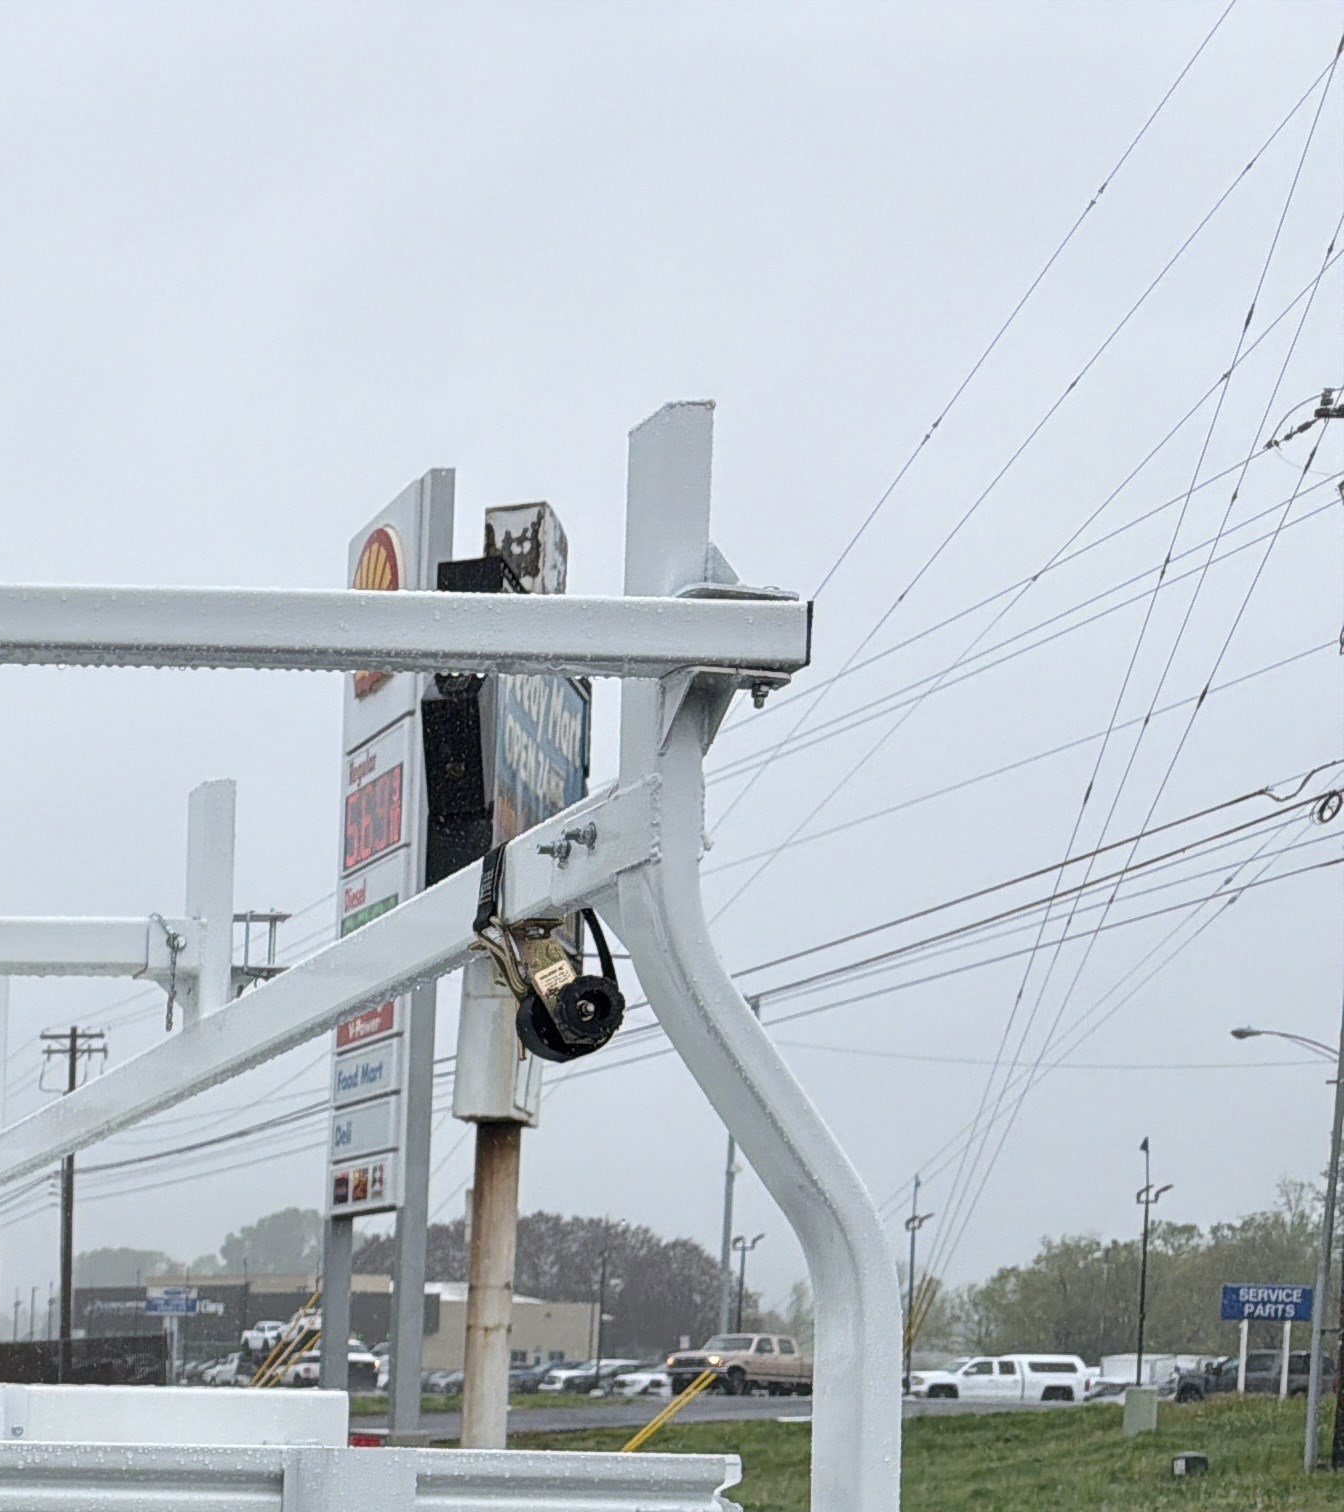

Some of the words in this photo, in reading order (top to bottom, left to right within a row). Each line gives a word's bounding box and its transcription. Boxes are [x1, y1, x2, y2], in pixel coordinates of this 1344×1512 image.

[338, 1066, 359, 1091] Food
[361, 1061, 383, 1085] Mart
[335, 1122, 353, 1147] Deli
[1238, 1287, 1303, 1303] SERVICE
[1243, 1303, 1296, 1318] PARTS
